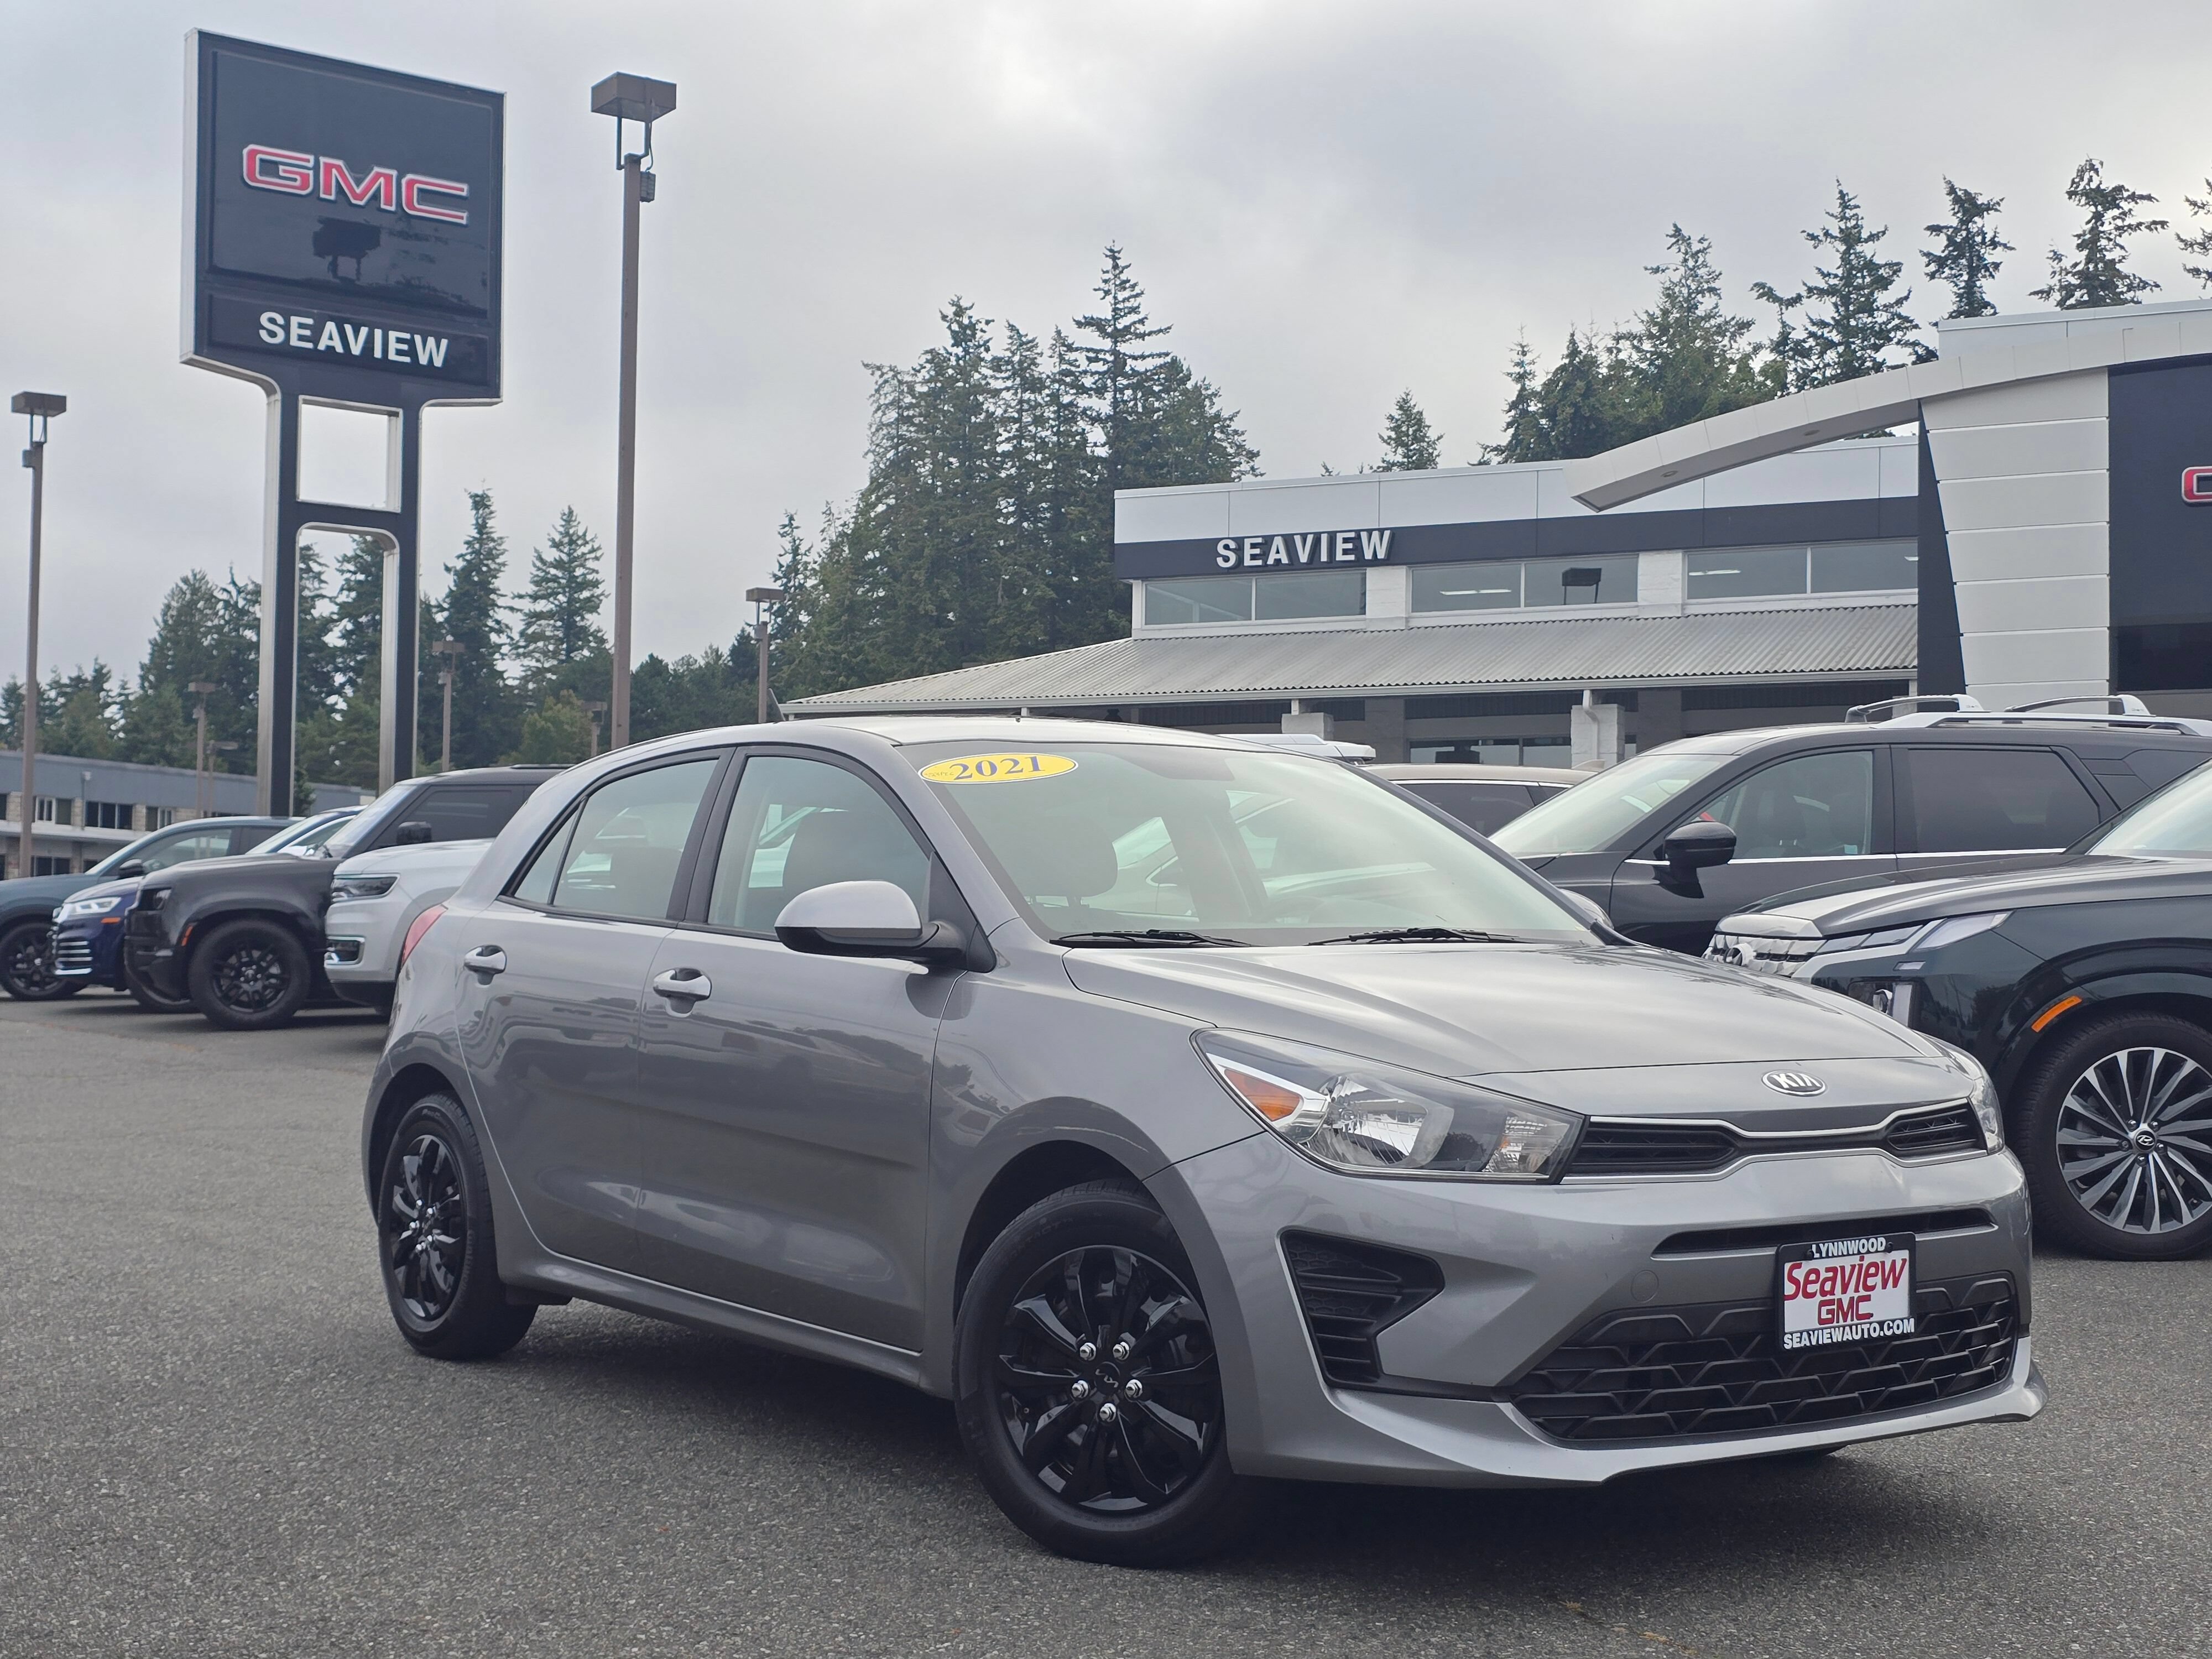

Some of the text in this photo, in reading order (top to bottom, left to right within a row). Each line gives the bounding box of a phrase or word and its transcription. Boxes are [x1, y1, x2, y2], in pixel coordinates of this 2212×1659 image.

[243, 144, 469, 225] GMC
[259, 311, 448, 367] SEAVIEW
[1216, 530, 1391, 568] SEAVIEW
[949, 755, 1045, 780] 2021
[1770, 1072, 1822, 1089] KIA
[1812, 1237, 1886, 1258] LYNNWOOD
[1784, 1255, 1907, 1301] Seaview
[1818, 1295, 1874, 1326] GMC
[1784, 1318, 1915, 1349] SEAVIEWAUTO.COM
